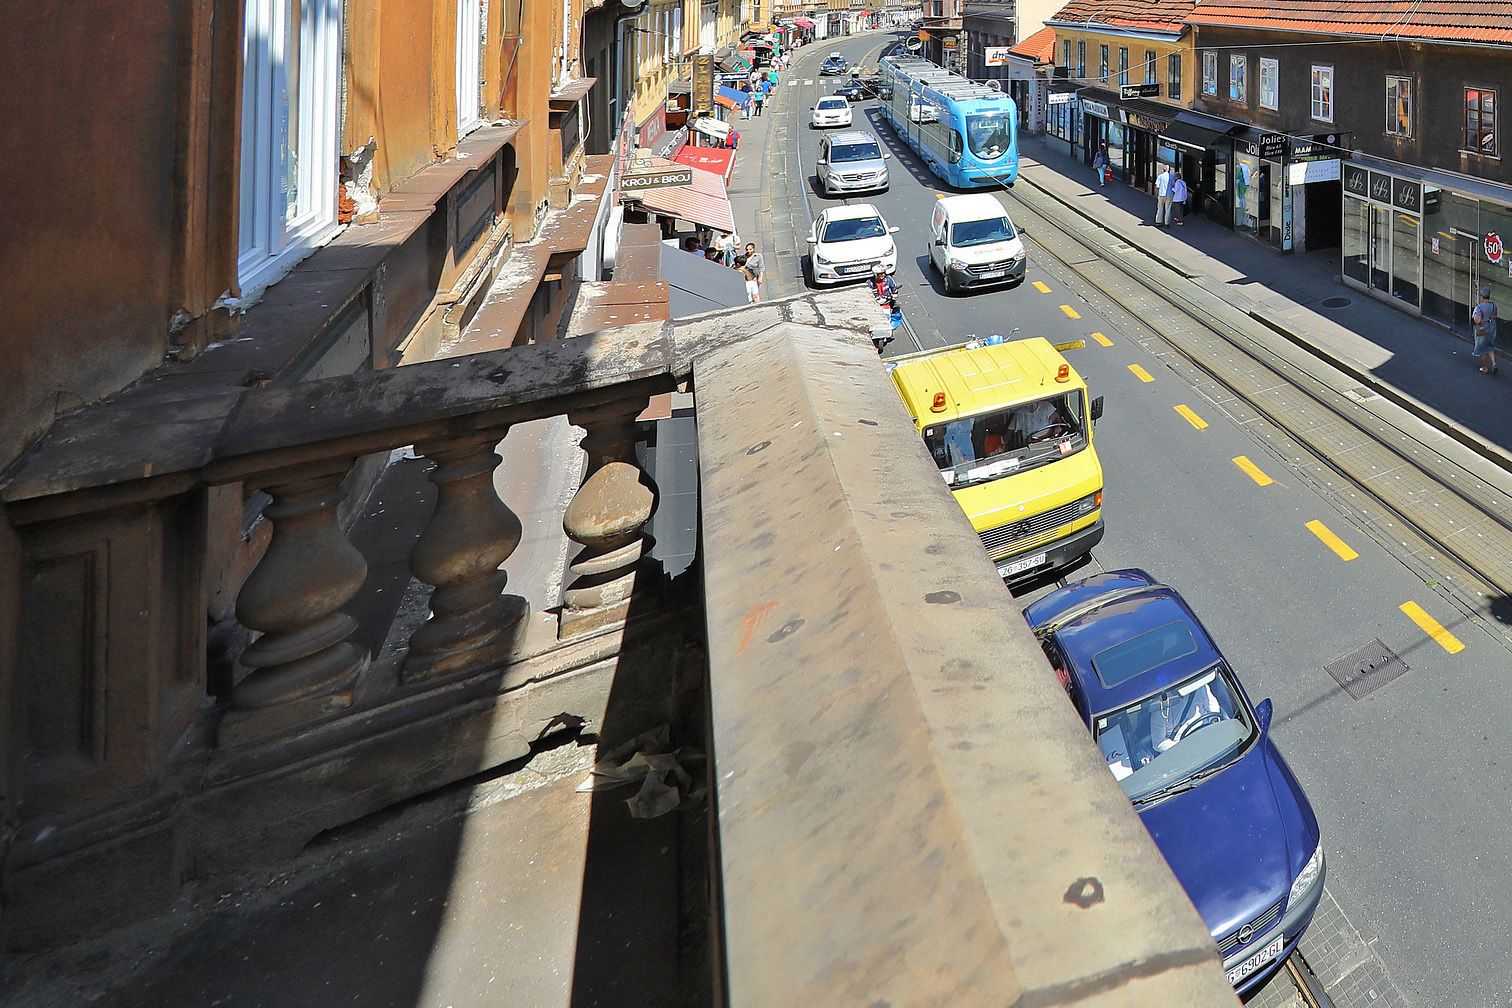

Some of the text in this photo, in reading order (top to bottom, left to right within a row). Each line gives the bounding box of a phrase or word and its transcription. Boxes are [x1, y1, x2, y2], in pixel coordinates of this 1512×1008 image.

[1261, 135, 1286, 146] Jolie's
[1246, 142, 1260, 156] Joli
[622, 177, 652, 188] KROJ
[661, 174, 691, 184] BROJ
[1487, 242, 1498, 254] 50
[1002, 566, 1013, 576] ZG
